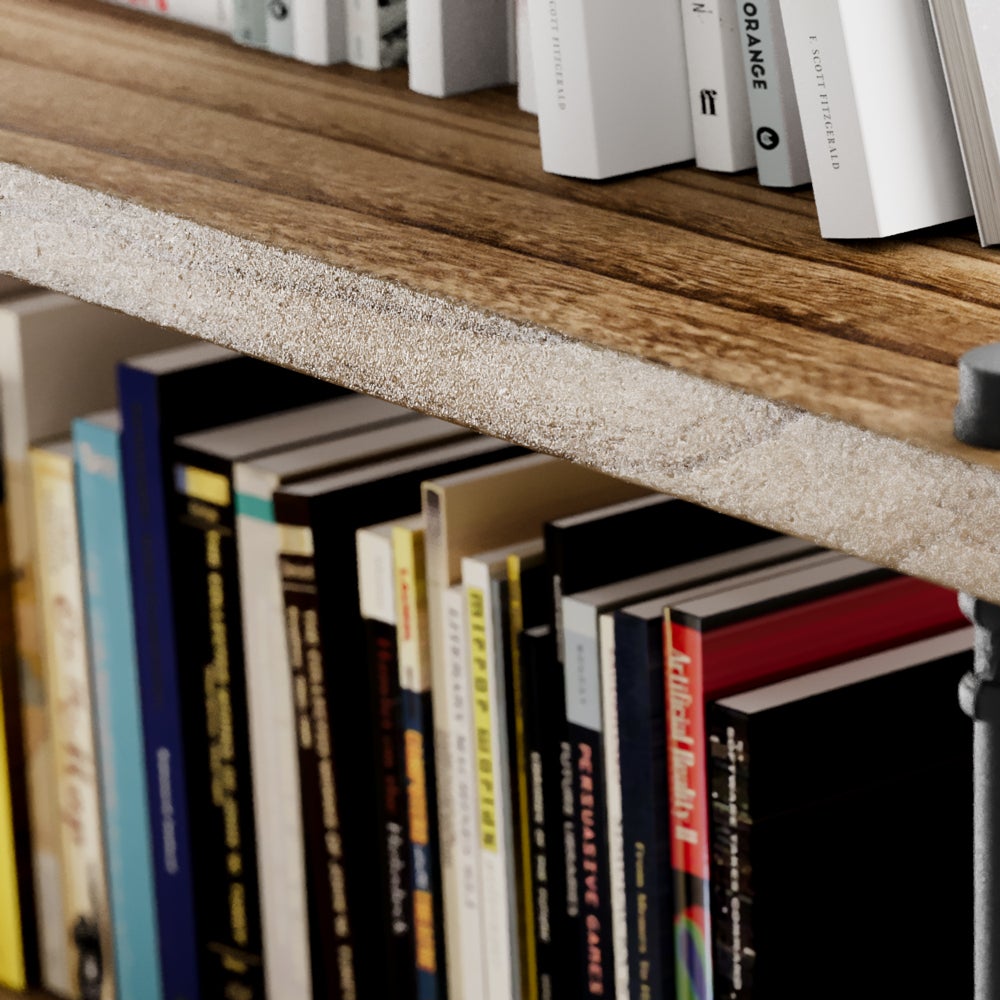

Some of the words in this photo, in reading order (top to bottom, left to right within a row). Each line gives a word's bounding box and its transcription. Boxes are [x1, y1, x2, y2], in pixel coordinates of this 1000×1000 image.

[743, 2, 767, 90] ORANGE
[811, 48, 827, 90] SCOTT
[819, 93, 840, 171] FITZGERALD
[666, 647, 694, 745] Artificial
[578, 742, 600, 909] PERSUASIVE
[668, 744, 697, 820] Reality
[585, 913, 604, 997] GAMES
